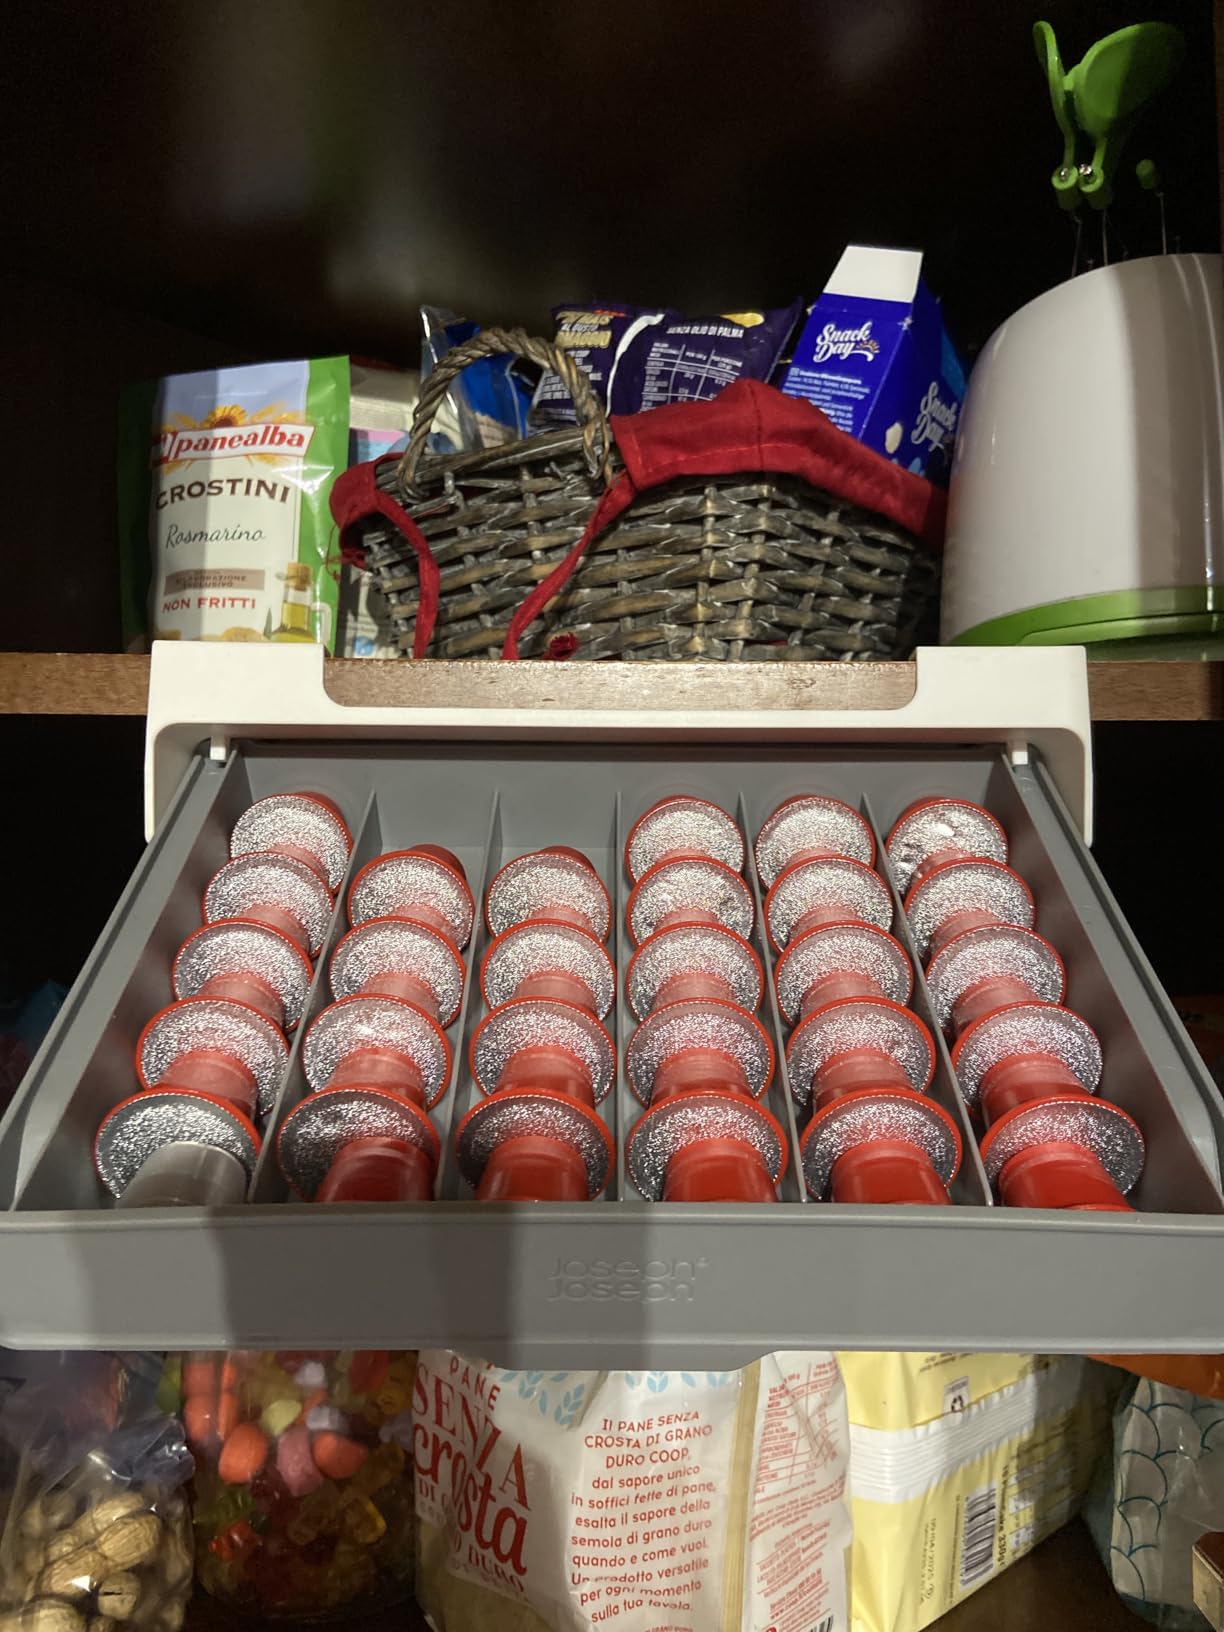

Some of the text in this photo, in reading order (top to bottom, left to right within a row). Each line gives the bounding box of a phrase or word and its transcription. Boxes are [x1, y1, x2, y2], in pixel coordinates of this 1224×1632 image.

[717, 326, 745, 339] PALMA
[816, 321, 873, 346] Snack
[813, 341, 875, 363] Day
[173, 425, 305, 460] panealba
[155, 478, 290, 511] CROSTINI
[165, 524, 266, 549] Rosmarino
[162, 597, 256, 613] NON FRITTI
[449, 1355, 501, 1411] PANE
[618, 1418, 653, 1432] PANE
[657, 1411, 700, 1427] SENZA
[412, 1362, 532, 1512] SENZA
[584, 1424, 713, 1449] CROSTA DI GRANO
[605, 1454, 645, 1469] DURO
[592, 1465, 700, 1490] dal sapore unico
[571, 1492, 583, 1507] in
[588, 1496, 630, 1510] soffici
[634, 1490, 662, 1504] fette
[666, 1486, 678, 1498] di
[575, 1499, 711, 1529] esalta il sapore della
[571, 1519, 712, 1548] semola di grano duro
[572, 1555, 626, 1568] quando
[630, 1555, 638, 1564] e
[642, 1546, 677, 1562] come
[657, 1557, 709, 1579] versatile
[580, 1579, 702, 1606] per ogni momento
[591, 1604, 620, 1623] sulla
[623, 1599, 644, 1611] tua
